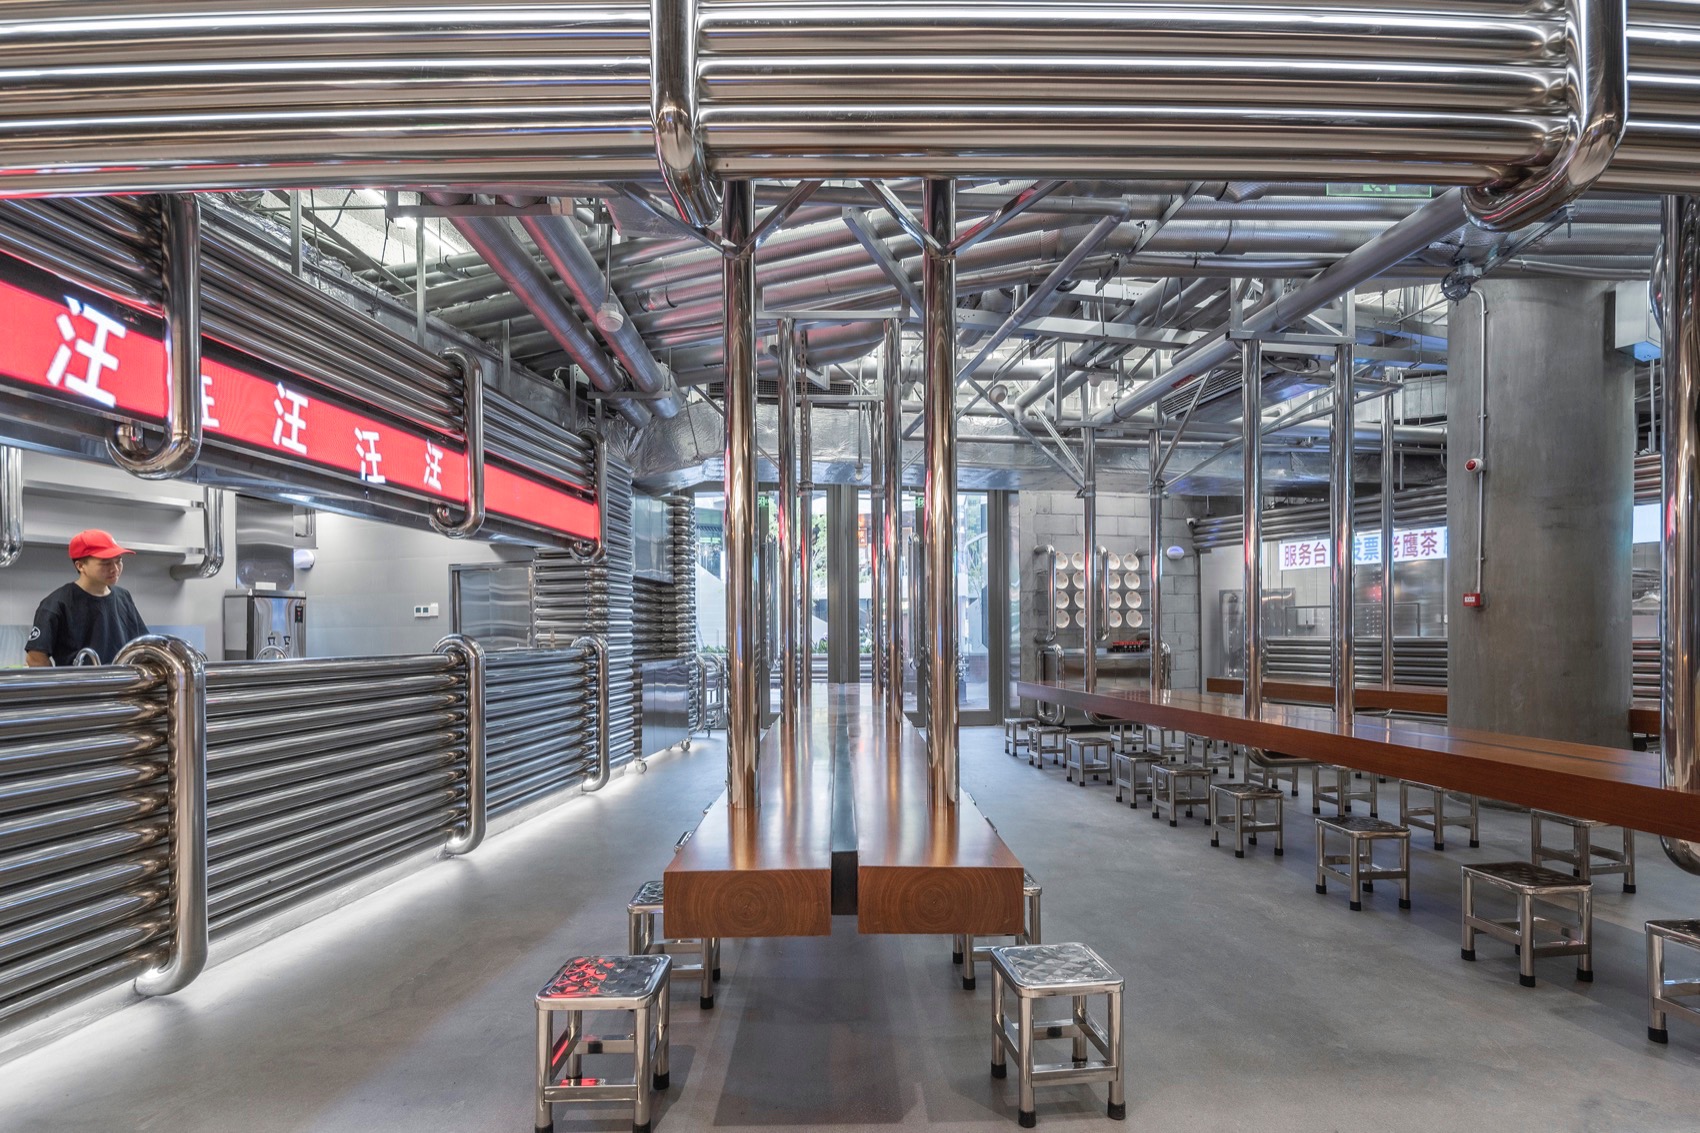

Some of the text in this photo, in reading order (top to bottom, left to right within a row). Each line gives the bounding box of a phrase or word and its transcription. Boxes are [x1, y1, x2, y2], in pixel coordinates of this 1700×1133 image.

[46, 295, 127, 408] 汪
[272, 382, 309, 455] 汪
[354, 426, 386, 484] 汪
[423, 439, 444, 490] 汪
[1284, 542, 1327, 567] 服务台
